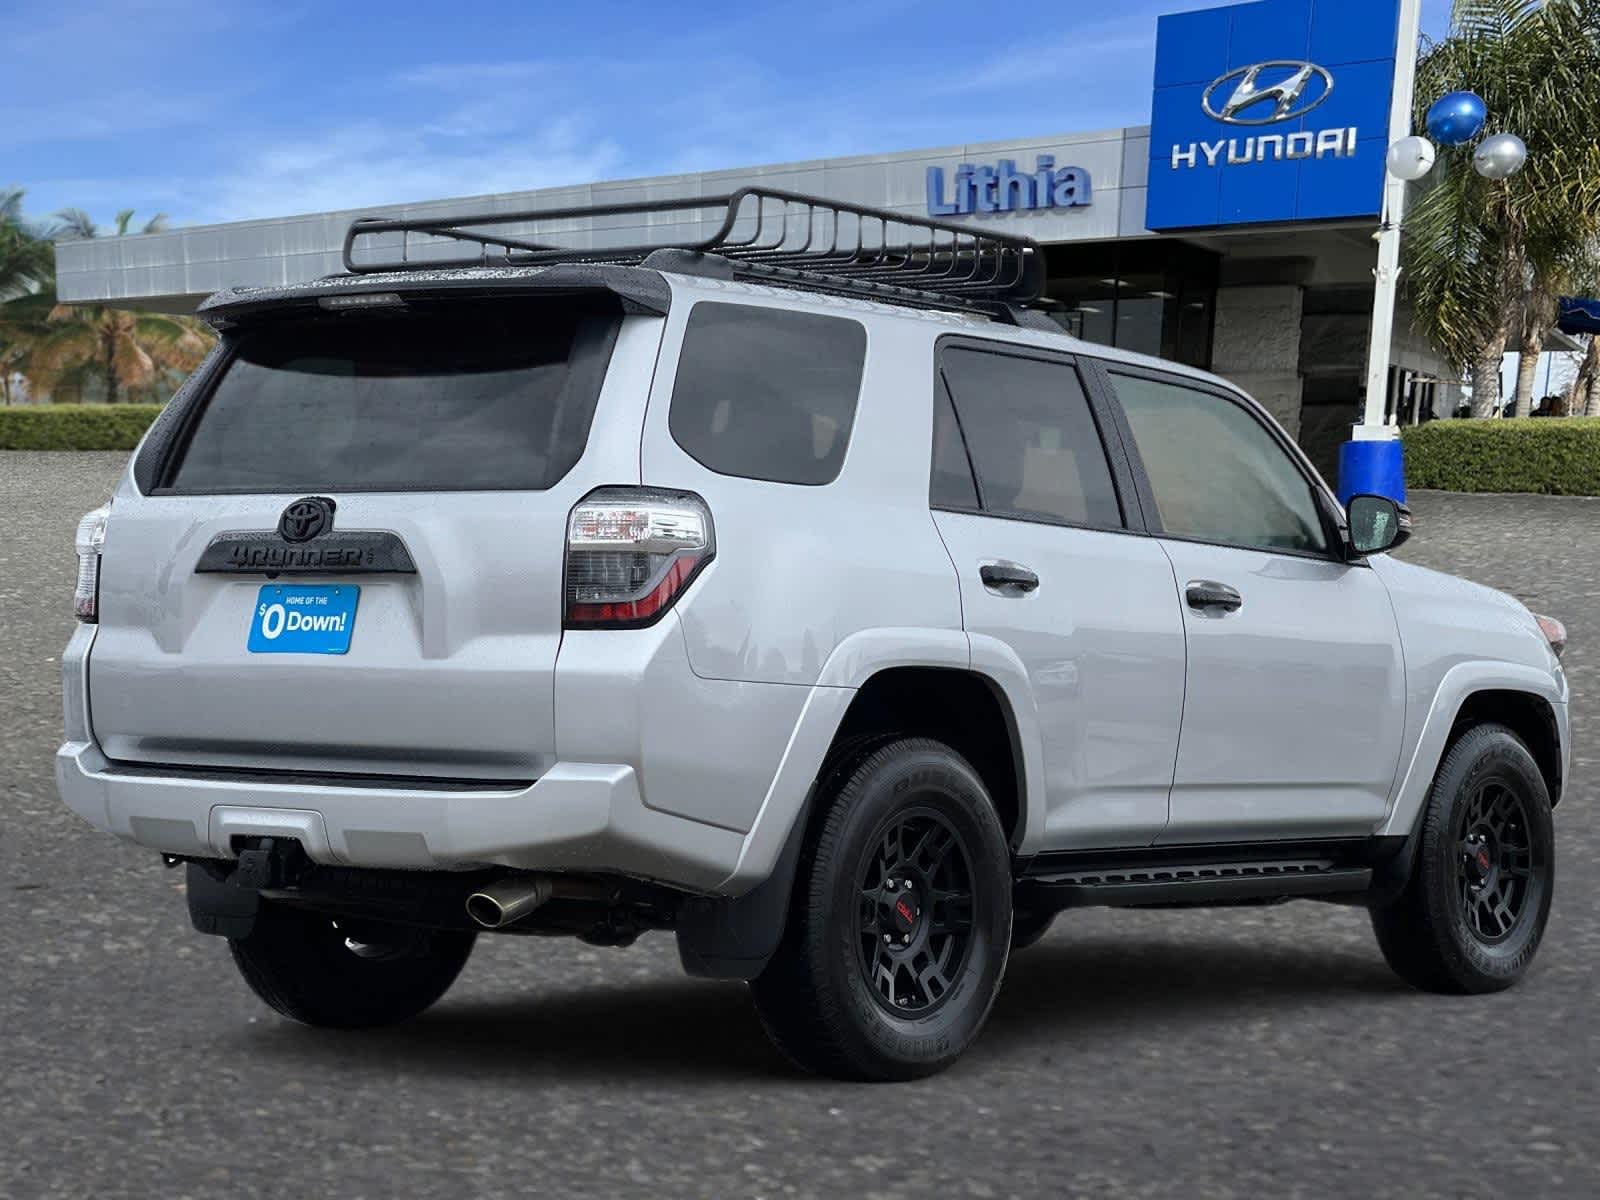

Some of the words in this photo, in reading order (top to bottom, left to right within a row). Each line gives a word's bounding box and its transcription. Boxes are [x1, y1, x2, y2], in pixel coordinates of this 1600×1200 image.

[1170, 127, 1357, 170] HYUNDAI
[925, 155, 1093, 217] Lithia
[286, 596, 304, 605] HOME
[305, 596, 315, 605] OF
[315, 596, 328, 605] THE
[286, 611, 347, 632] Down!
